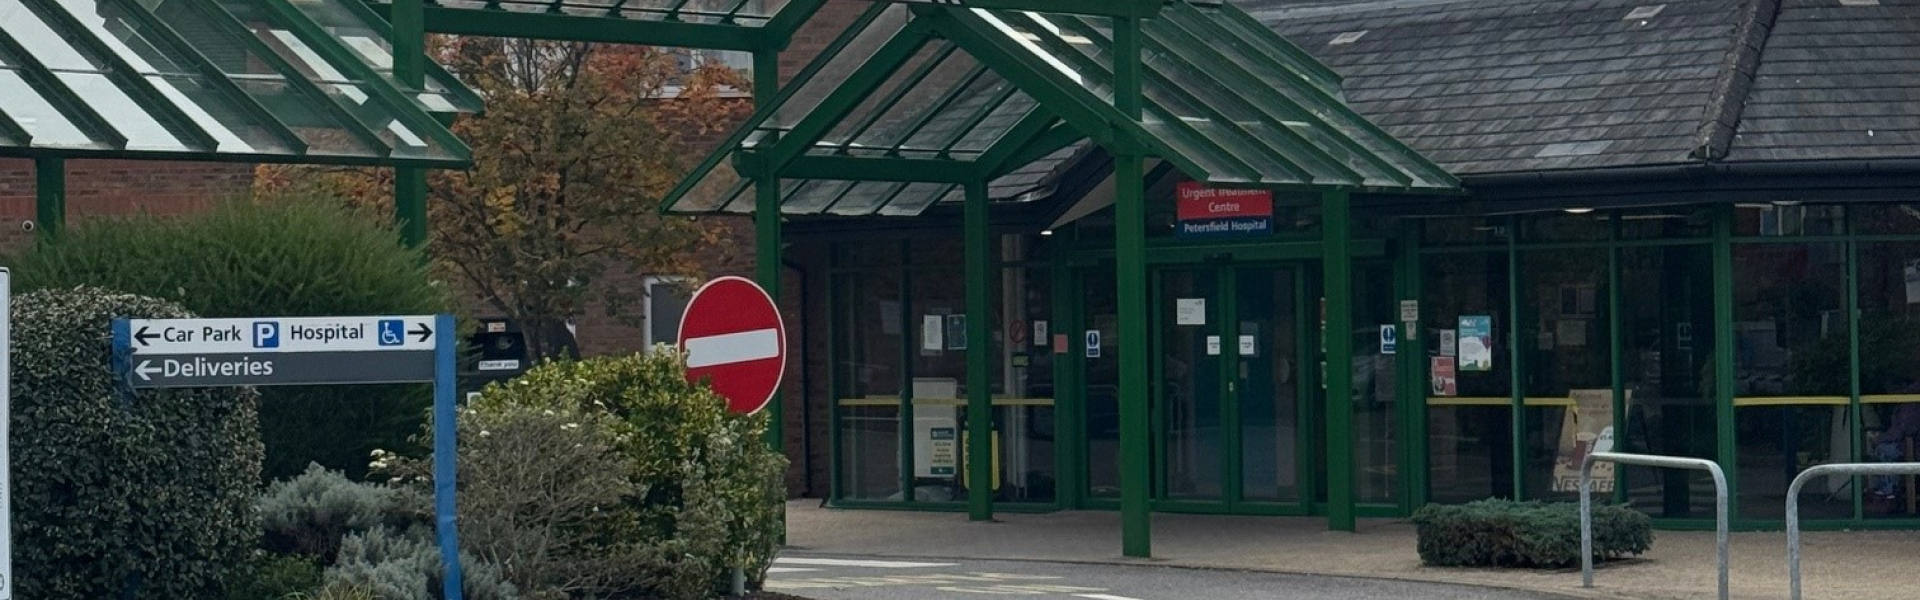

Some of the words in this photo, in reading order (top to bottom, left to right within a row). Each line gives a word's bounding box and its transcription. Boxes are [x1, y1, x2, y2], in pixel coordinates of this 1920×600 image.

[1182, 187, 1215, 200] Urgent
[1208, 201, 1240, 213] Centre
[1184, 221, 1228, 233] Petersfield
[1231, 219, 1266, 232] Hospital
[164, 327, 194, 342] Car
[202, 325, 242, 342] Park
[257, 323, 275, 346] P
[291, 323, 364, 344] Hospital
[164, 356, 273, 377] Deliveries
